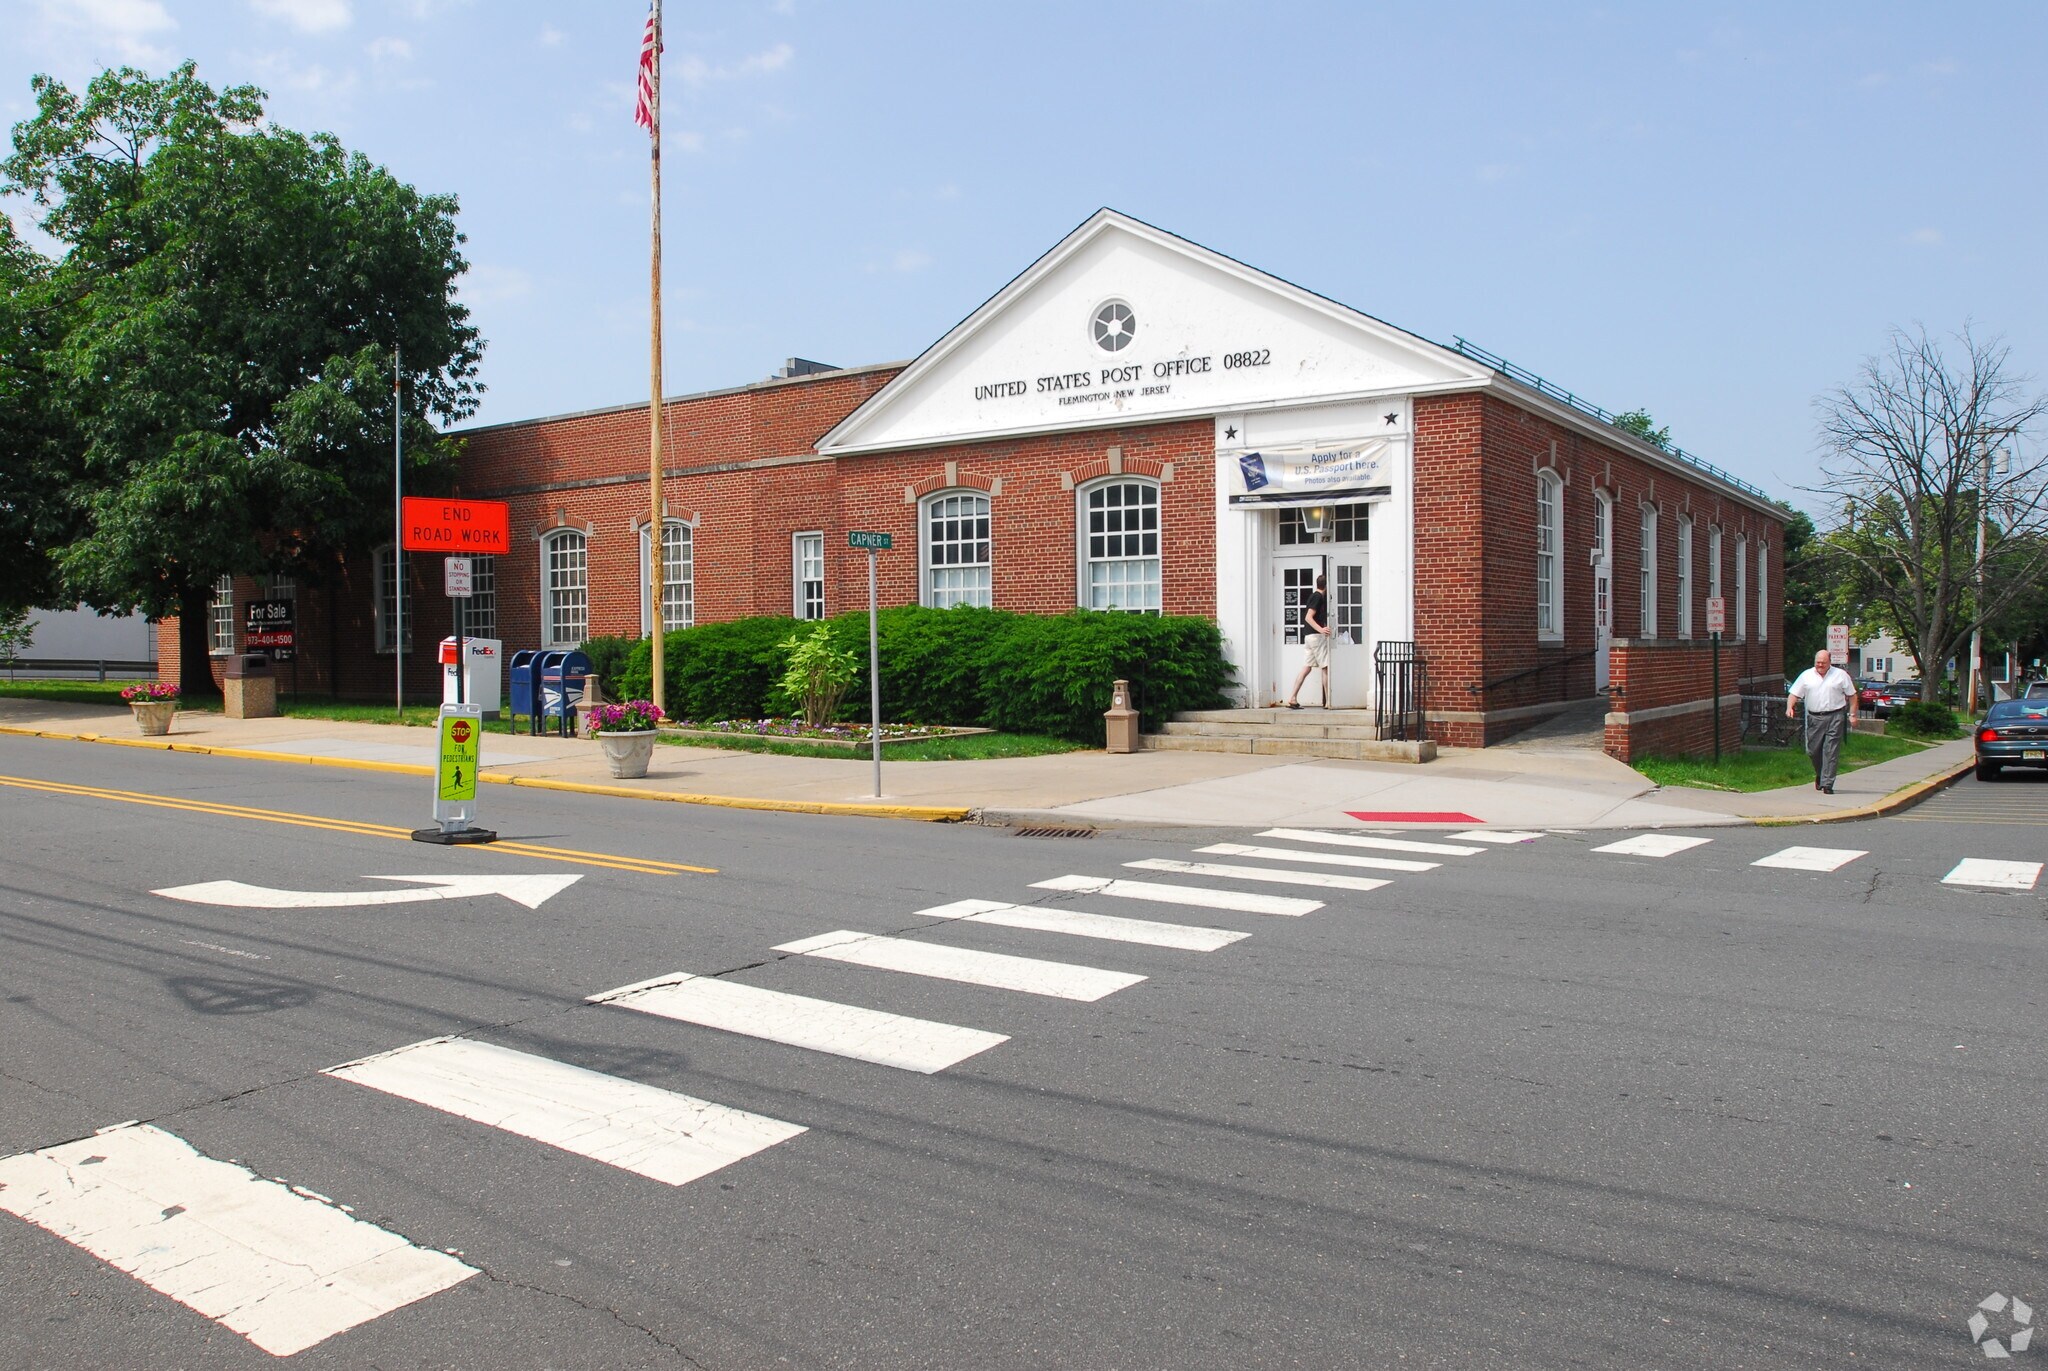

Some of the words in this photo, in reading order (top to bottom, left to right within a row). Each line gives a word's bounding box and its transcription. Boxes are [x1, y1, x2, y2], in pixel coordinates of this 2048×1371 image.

[975, 380, 1027, 400] UNITED
[1036, 372, 1091, 393] STATES
[1101, 365, 1142, 384] POST
[1153, 356, 1212, 378] OFFICE
[1223, 349, 1271, 370] 08822
[1058, 392, 1110, 406] FLEMINGTON
[1115, 389, 1135, 399] NEW
[1140, 385, 1171, 396] JERSEY
[1311, 452, 1337, 464] Apply
[1339, 451, 1353, 460] for
[1295, 465, 1311, 475] U.S.
[1314, 462, 1353, 474] Passport
[1355, 461, 1379, 470] here.
[1304, 477, 1326, 485] Photos
[1342, 474, 1372, 482] available.
[443, 507, 471, 521] END
[413, 527, 452, 541] ROAD
[461, 529, 500, 544] WORK
[850, 533, 882, 546] CAPNER
[453, 562, 464, 571] NO
[250, 604, 265, 619] For
[267, 603, 286, 619] Sale
[247, 635, 293, 645] 973-404-1500
[472, 646, 494, 656] FedEx
[447, 667, 459, 677] Fed
[451, 727, 471, 737] STOP
[454, 744, 465, 753] FOR
[443, 754, 475, 763] PEDESTRIANS
